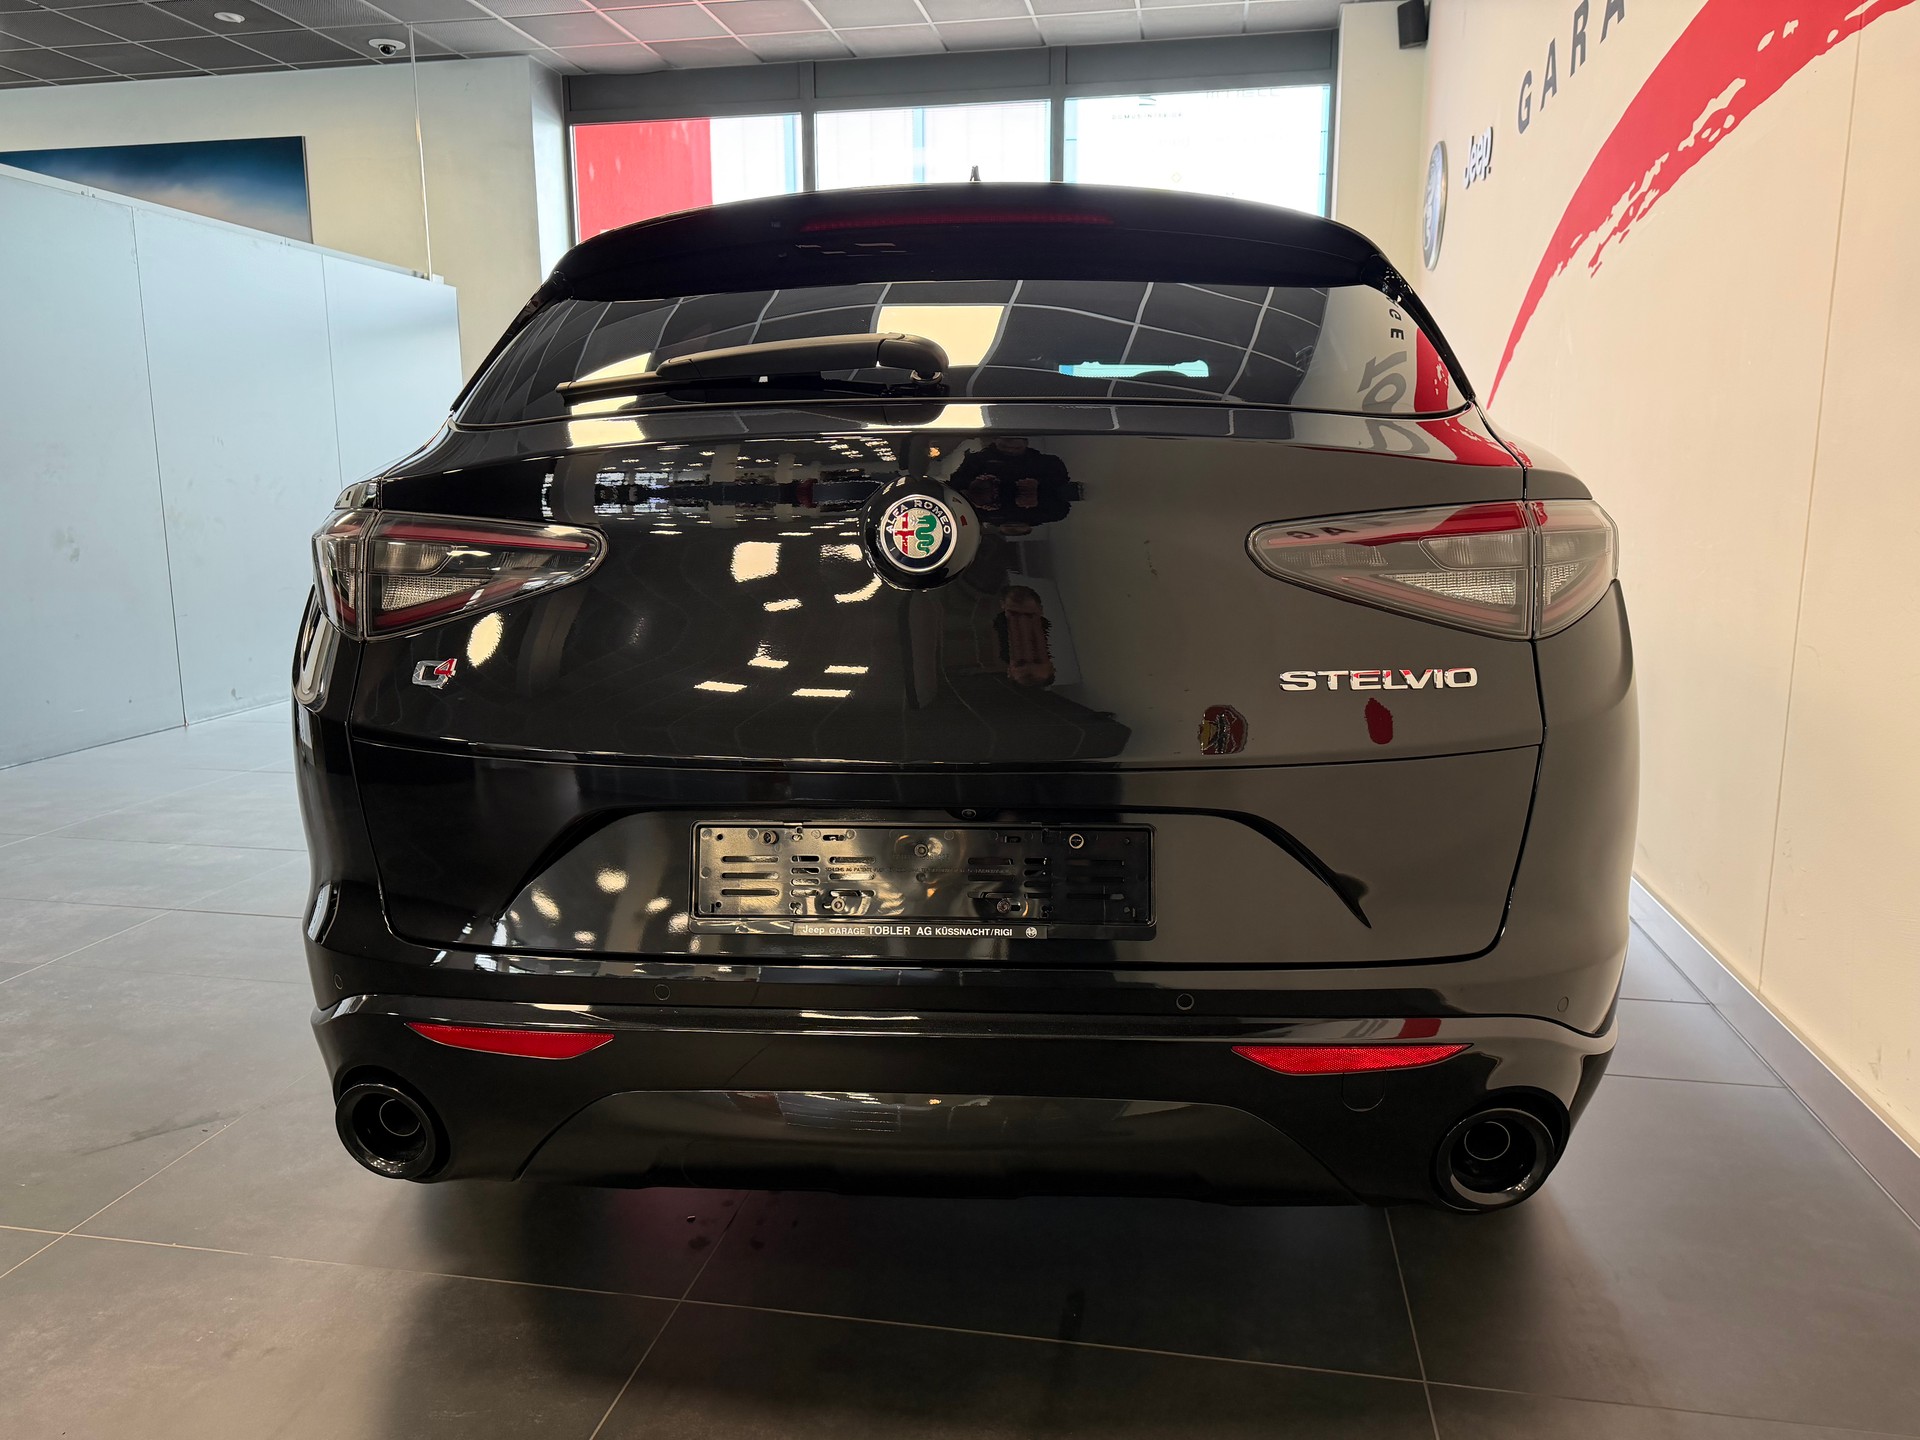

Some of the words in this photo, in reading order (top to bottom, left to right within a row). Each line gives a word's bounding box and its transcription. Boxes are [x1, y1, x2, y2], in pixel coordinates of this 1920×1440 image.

[886, 505, 909, 534] ALFA
[914, 499, 951, 534] ROMEO
[412, 658, 458, 690] Q4
[1279, 667, 1478, 691] STELVIO
[802, 925, 825, 935] Jeep
[828, 927, 865, 935] GARAGE
[868, 926, 911, 935] TOBLER
[916, 926, 932, 936] AG
[935, 926, 1013, 936] KÜSSNACHT/RIGI
